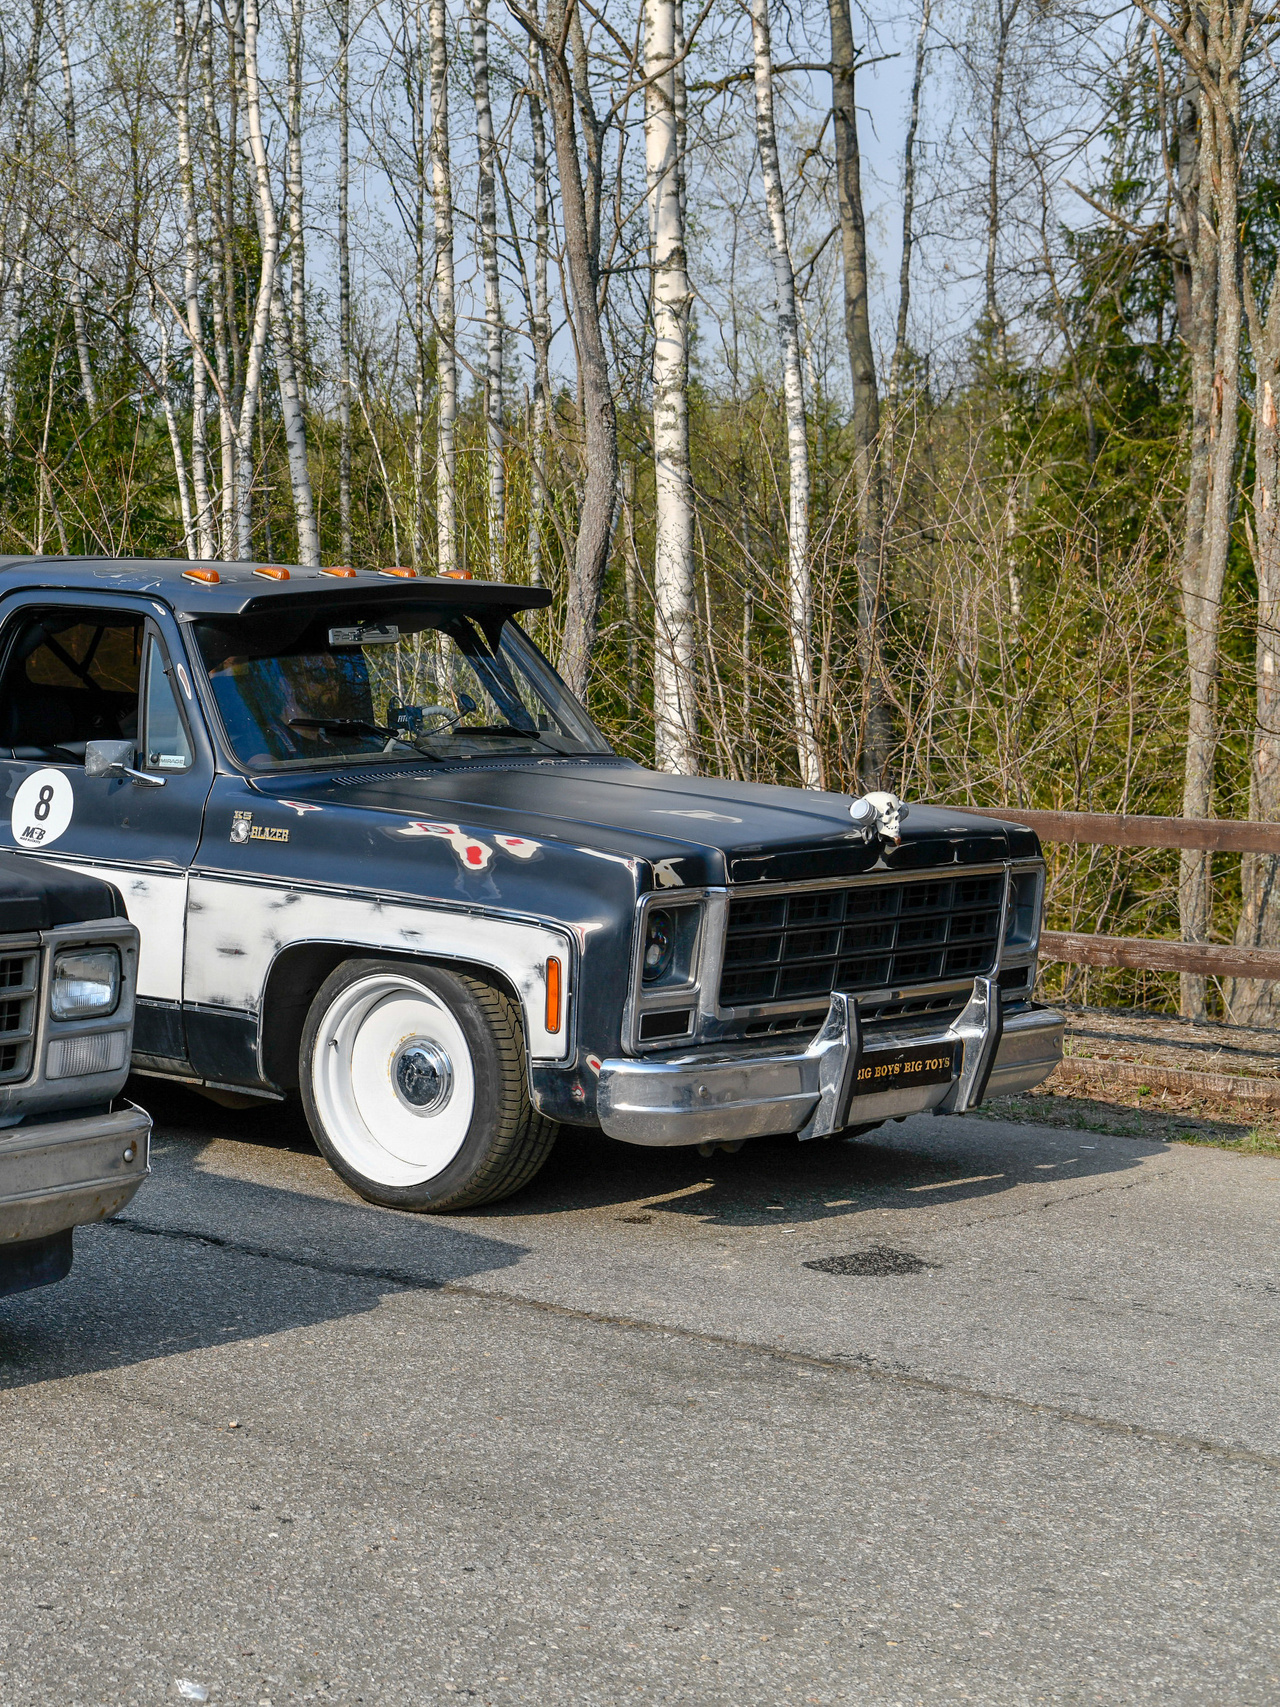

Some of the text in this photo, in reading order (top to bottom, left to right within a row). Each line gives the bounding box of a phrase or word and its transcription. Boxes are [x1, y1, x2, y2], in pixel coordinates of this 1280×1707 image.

[34, 784, 54, 821] 8
[233, 810, 252, 820] K5
[250, 825, 289, 842] BLAZER
[903, 1060, 923, 1073] BIG
[924, 1057, 950, 1070] TOYS
